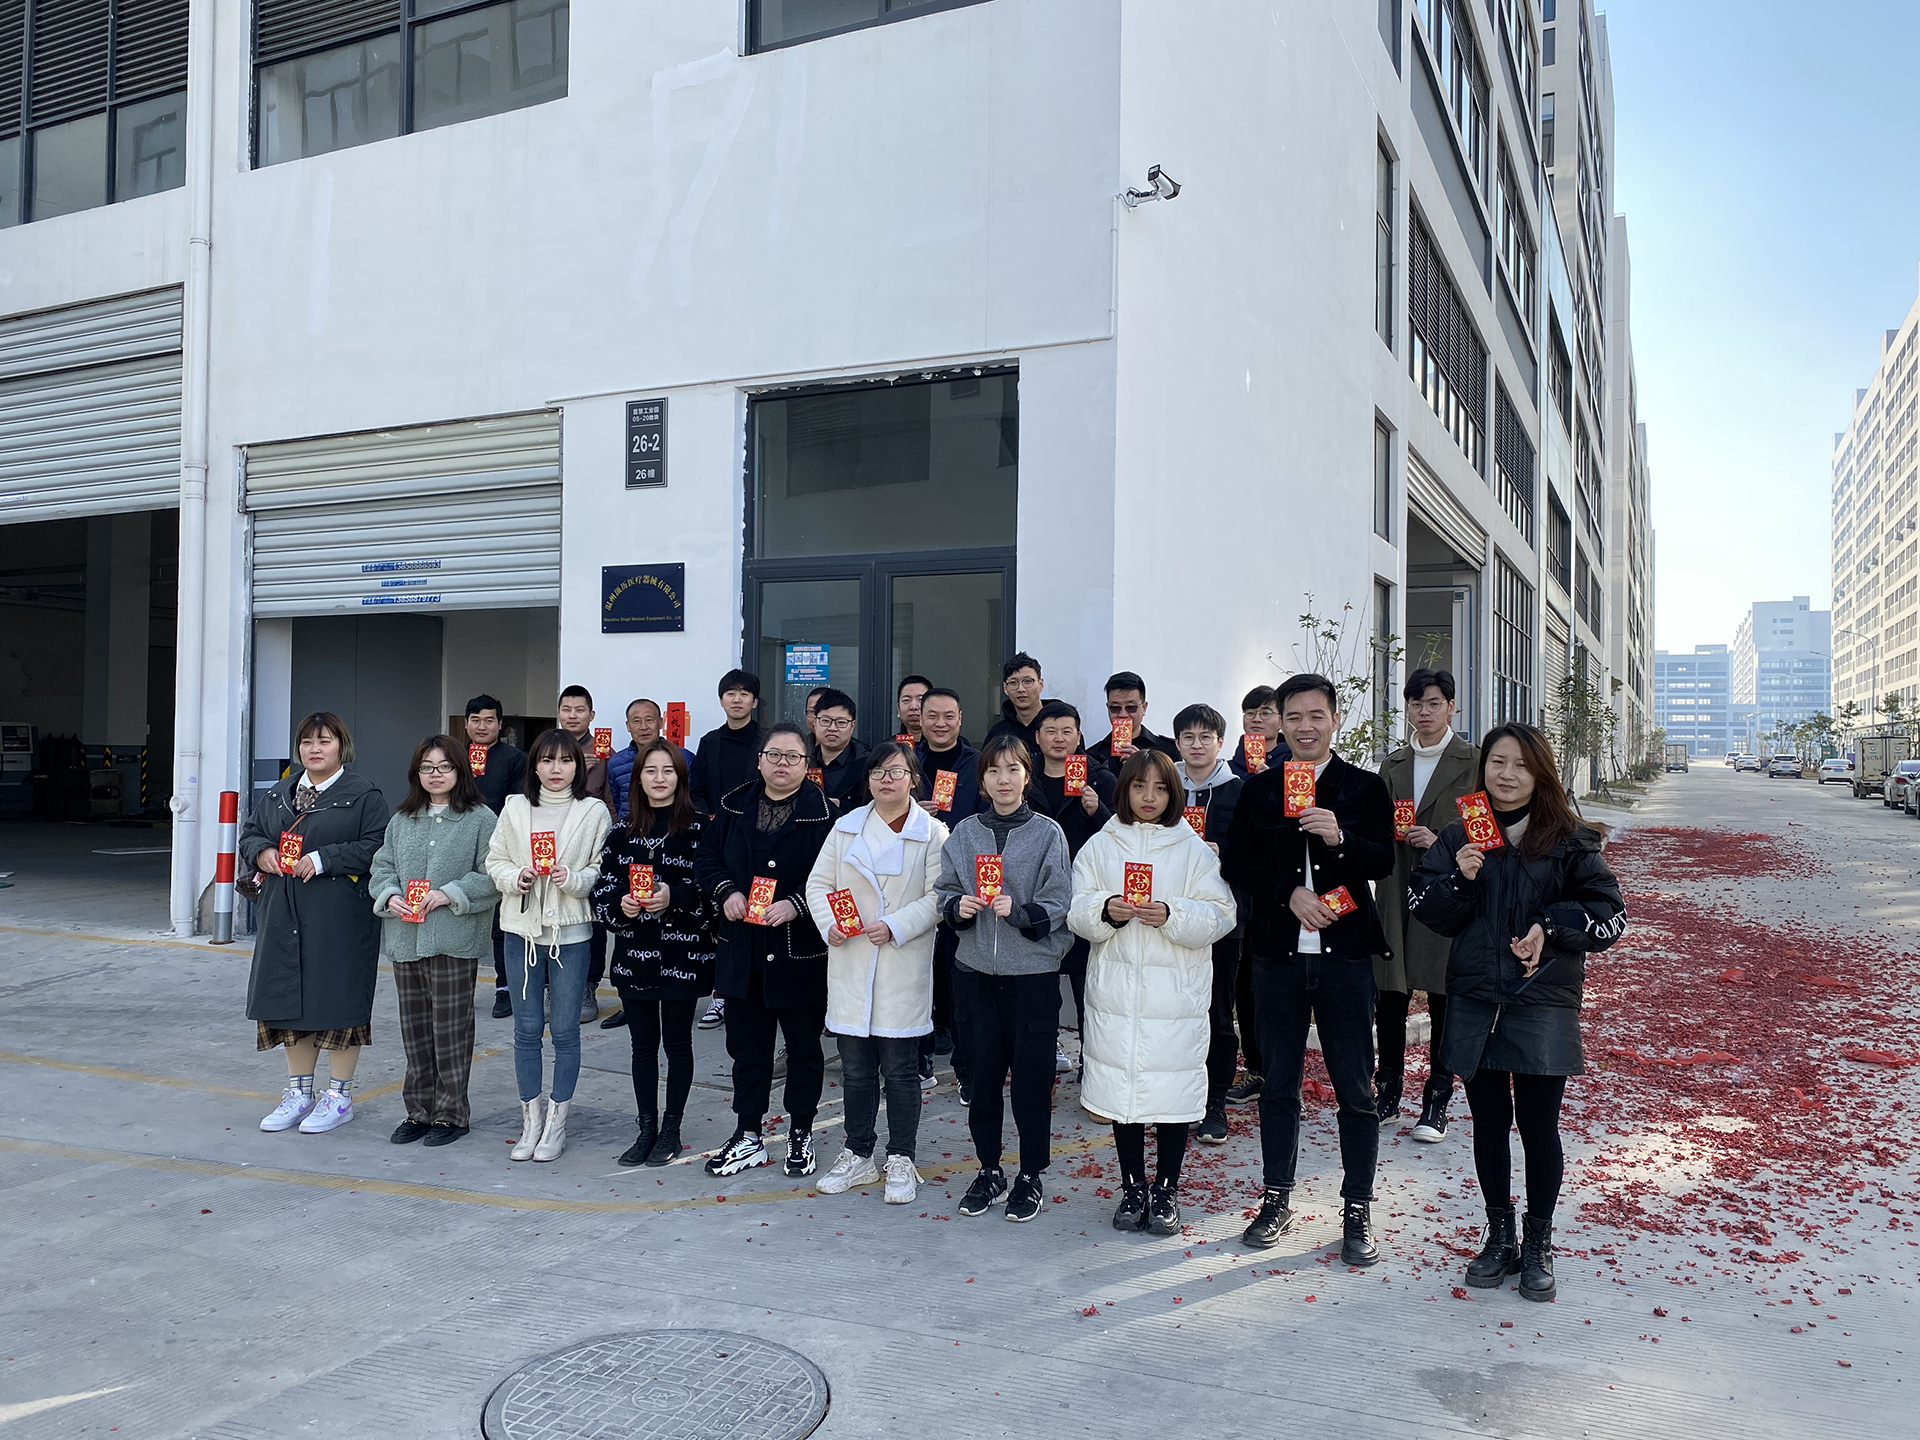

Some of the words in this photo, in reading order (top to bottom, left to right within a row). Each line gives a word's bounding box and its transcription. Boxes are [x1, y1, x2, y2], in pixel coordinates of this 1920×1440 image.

[632, 433, 660, 453] 26-2
[661, 930, 700, 942] lookun
[661, 966, 697, 981] lookun
